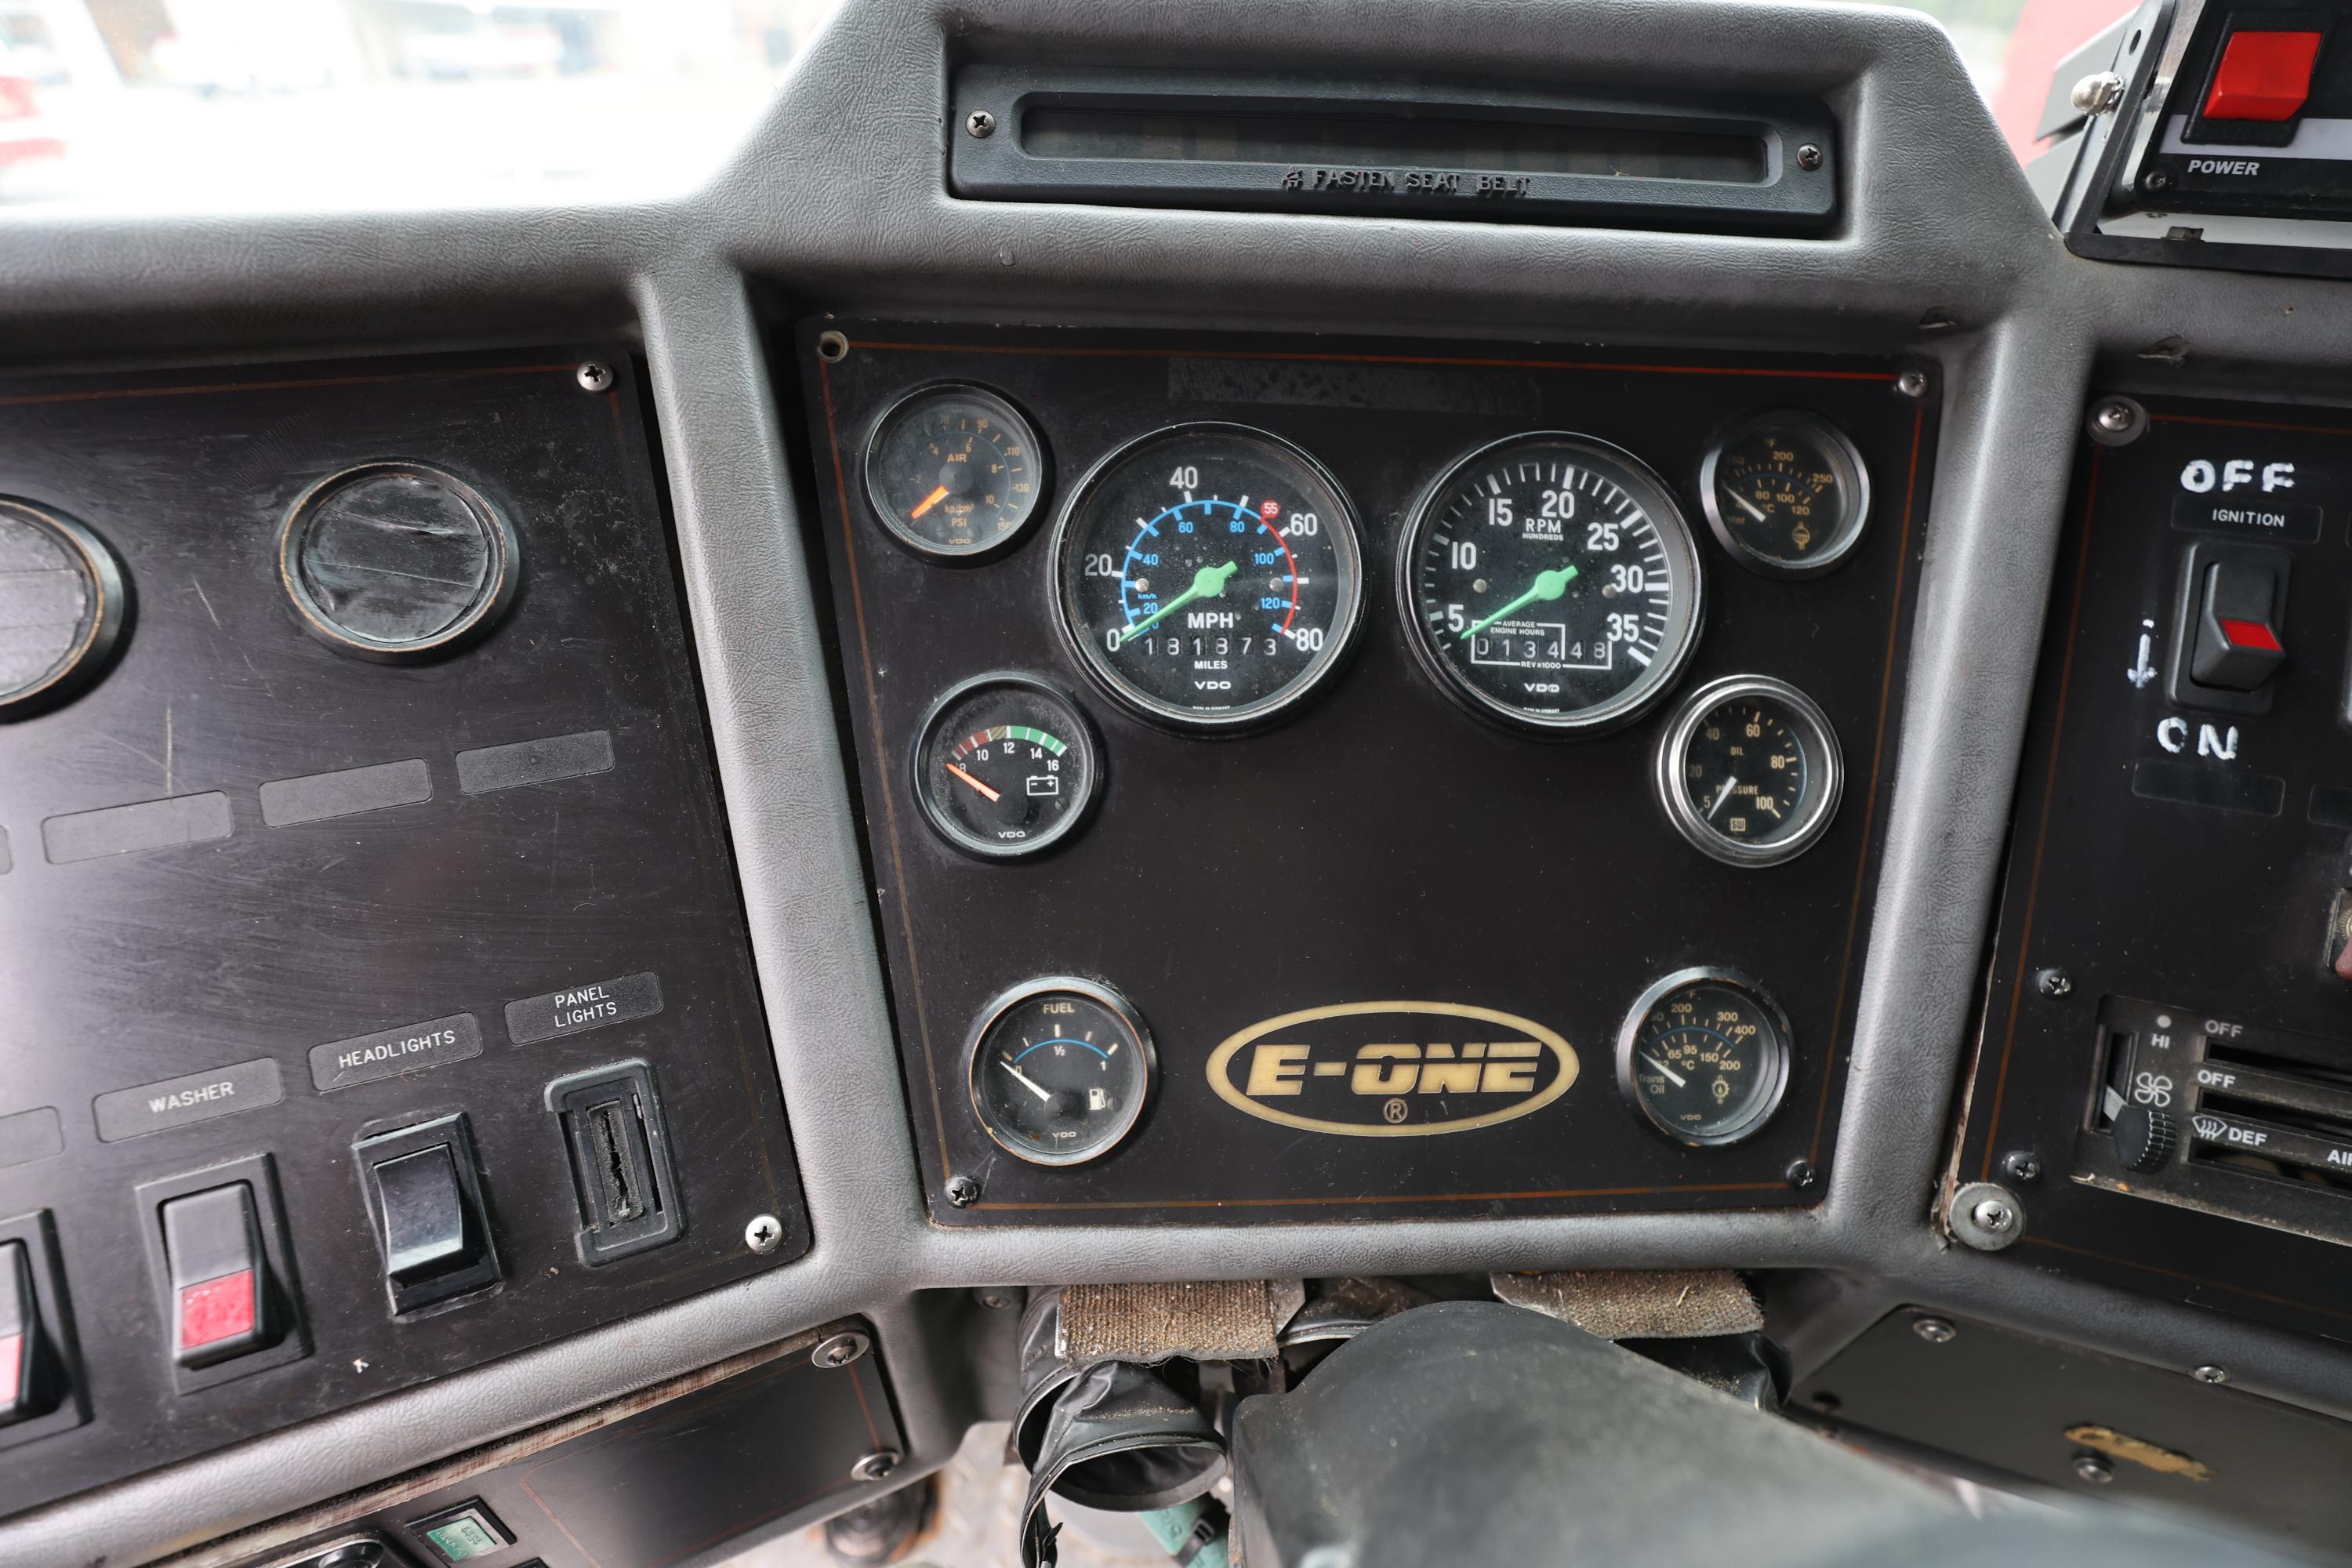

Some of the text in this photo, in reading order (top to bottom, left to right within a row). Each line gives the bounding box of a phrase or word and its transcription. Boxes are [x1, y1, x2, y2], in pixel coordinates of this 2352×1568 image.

[2187, 159, 2259, 176] POWER
[1312, 168, 1530, 197] FASTEN SEAT BELT
[947, 453, 967, 463] AIR
[1773, 451, 1794, 461] 200
[991, 464, 998, 474] 8
[1170, 466, 1199, 490] 40
[1813, 474, 1833, 484] 250
[2180, 459, 2296, 493] OFF
[1015, 483, 1029, 492] 130
[1755, 490, 1770, 500] 80
[1776, 493, 1795, 503] 100
[1264, 503, 1279, 514] 55
[1541, 490, 1575, 519] 20
[1490, 498, 1513, 527] 15
[1792, 506, 1810, 516] 120
[951, 517, 967, 528] PSI
[2212, 508, 2285, 528] IGNITION
[1178, 521, 1194, 534] 60
[1229, 521, 1246, 533] 80
[1290, 513, 1318, 536] 60
[1525, 517, 1562, 534] RPM
[1523, 532, 1564, 542] HUNDREDS
[1587, 522, 1620, 552] 25
[1142, 554, 1159, 566] 40
[1254, 554, 1275, 565] 100
[1451, 542, 1476, 570] 10
[1084, 554, 1113, 576] 20
[1610, 564, 1643, 593] 30
[1143, 602, 1158, 615] 20
[1261, 598, 1281, 609] 120
[1188, 612, 1233, 629] MPH
[1448, 604, 1465, 633] 5
[1502, 620, 1537, 629] AVERAGE
[1519, 628, 1545, 637] HOURS
[1606, 612, 1639, 643] 35
[1106, 629, 1121, 652] 0
[1295, 628, 1323, 652] 80
[1194, 660, 1228, 670] MILES
[1520, 660, 1537, 669] REV
[1194, 681, 1232, 690] VDO
[1523, 683, 1560, 693] VDO
[1705, 728, 1720, 741] 40
[1746, 724, 1760, 737] 60
[2157, 717, 2238, 760] ON
[1003, 742, 1015, 754] 12
[1030, 748, 1042, 759] 14
[1730, 746, 1744, 756] OIL
[976, 750, 989, 761] 10
[959, 763, 967, 773] 8
[1047, 760, 1059, 771] 16
[1770, 755, 1785, 769] 80
[1704, 796, 1711, 809] 5
[1755, 796, 1773, 810] 100
[555, 985, 611, 1010] PANEL
[1044, 1004, 1074, 1014] FUEL
[1671, 1004, 1692, 1013] 200
[554, 1001, 618, 1029] LIGHTS
[1717, 1011, 1738, 1022] 300
[1734, 1025, 1756, 1036] 400
[2205, 1019, 2243, 1037] OFF
[2151, 1033, 2170, 1049] HI
[338, 1029, 456, 1069] HEADLIGHTS
[1668, 1049, 1682, 1059] 65
[1683, 1044, 1697, 1054] 95
[1700, 1053, 1719, 1062] 150
[1247, 1042, 1541, 1095] E-ONE
[1719, 1060, 1740, 1070] 200
[1639, 1074, 1665, 1083] Trans
[2197, 1069, 2235, 1087] OFF
[1650, 1085, 1665, 1094] Oil
[147, 1081, 234, 1113] WASHER
[2228, 1127, 2267, 1145] DEF
